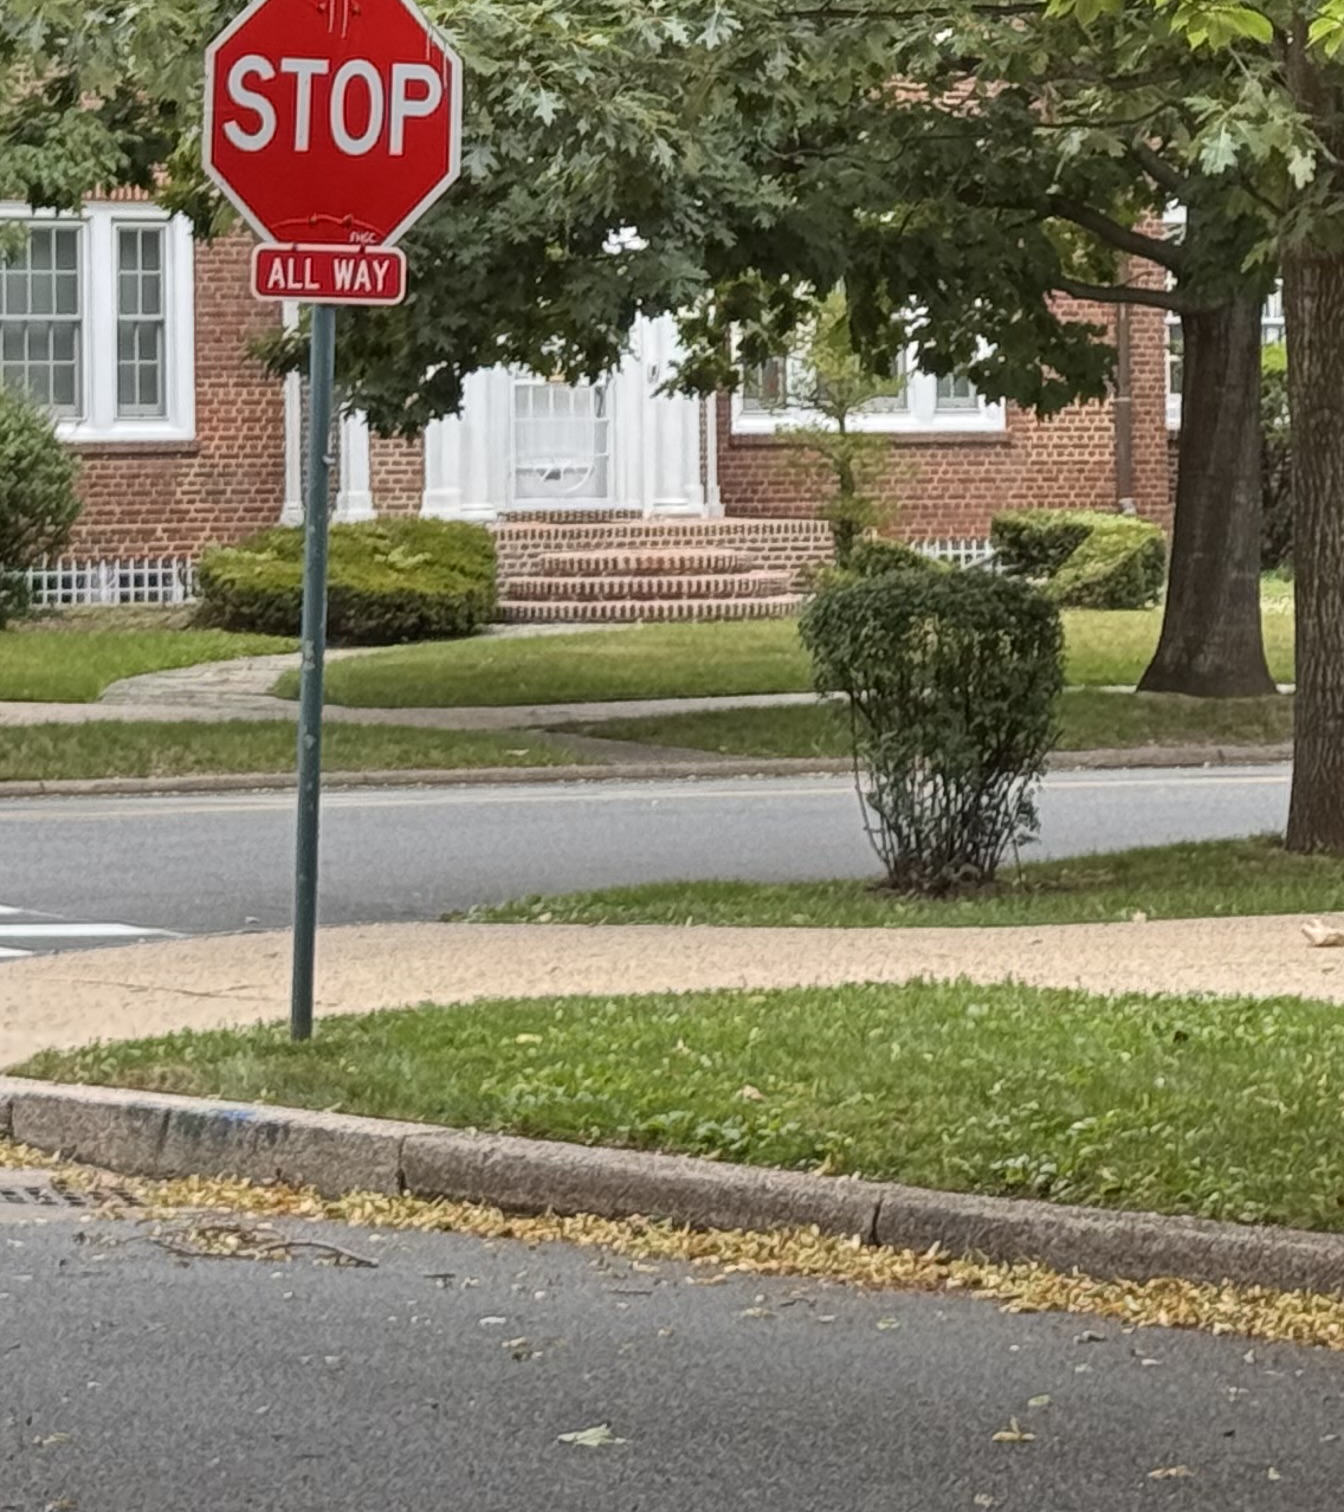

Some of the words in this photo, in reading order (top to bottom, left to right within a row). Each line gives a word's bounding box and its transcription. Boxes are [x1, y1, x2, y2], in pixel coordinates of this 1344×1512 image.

[223, 55, 443, 156] STOP
[267, 257, 320, 290] ALL
[333, 258, 390, 292] WAY
